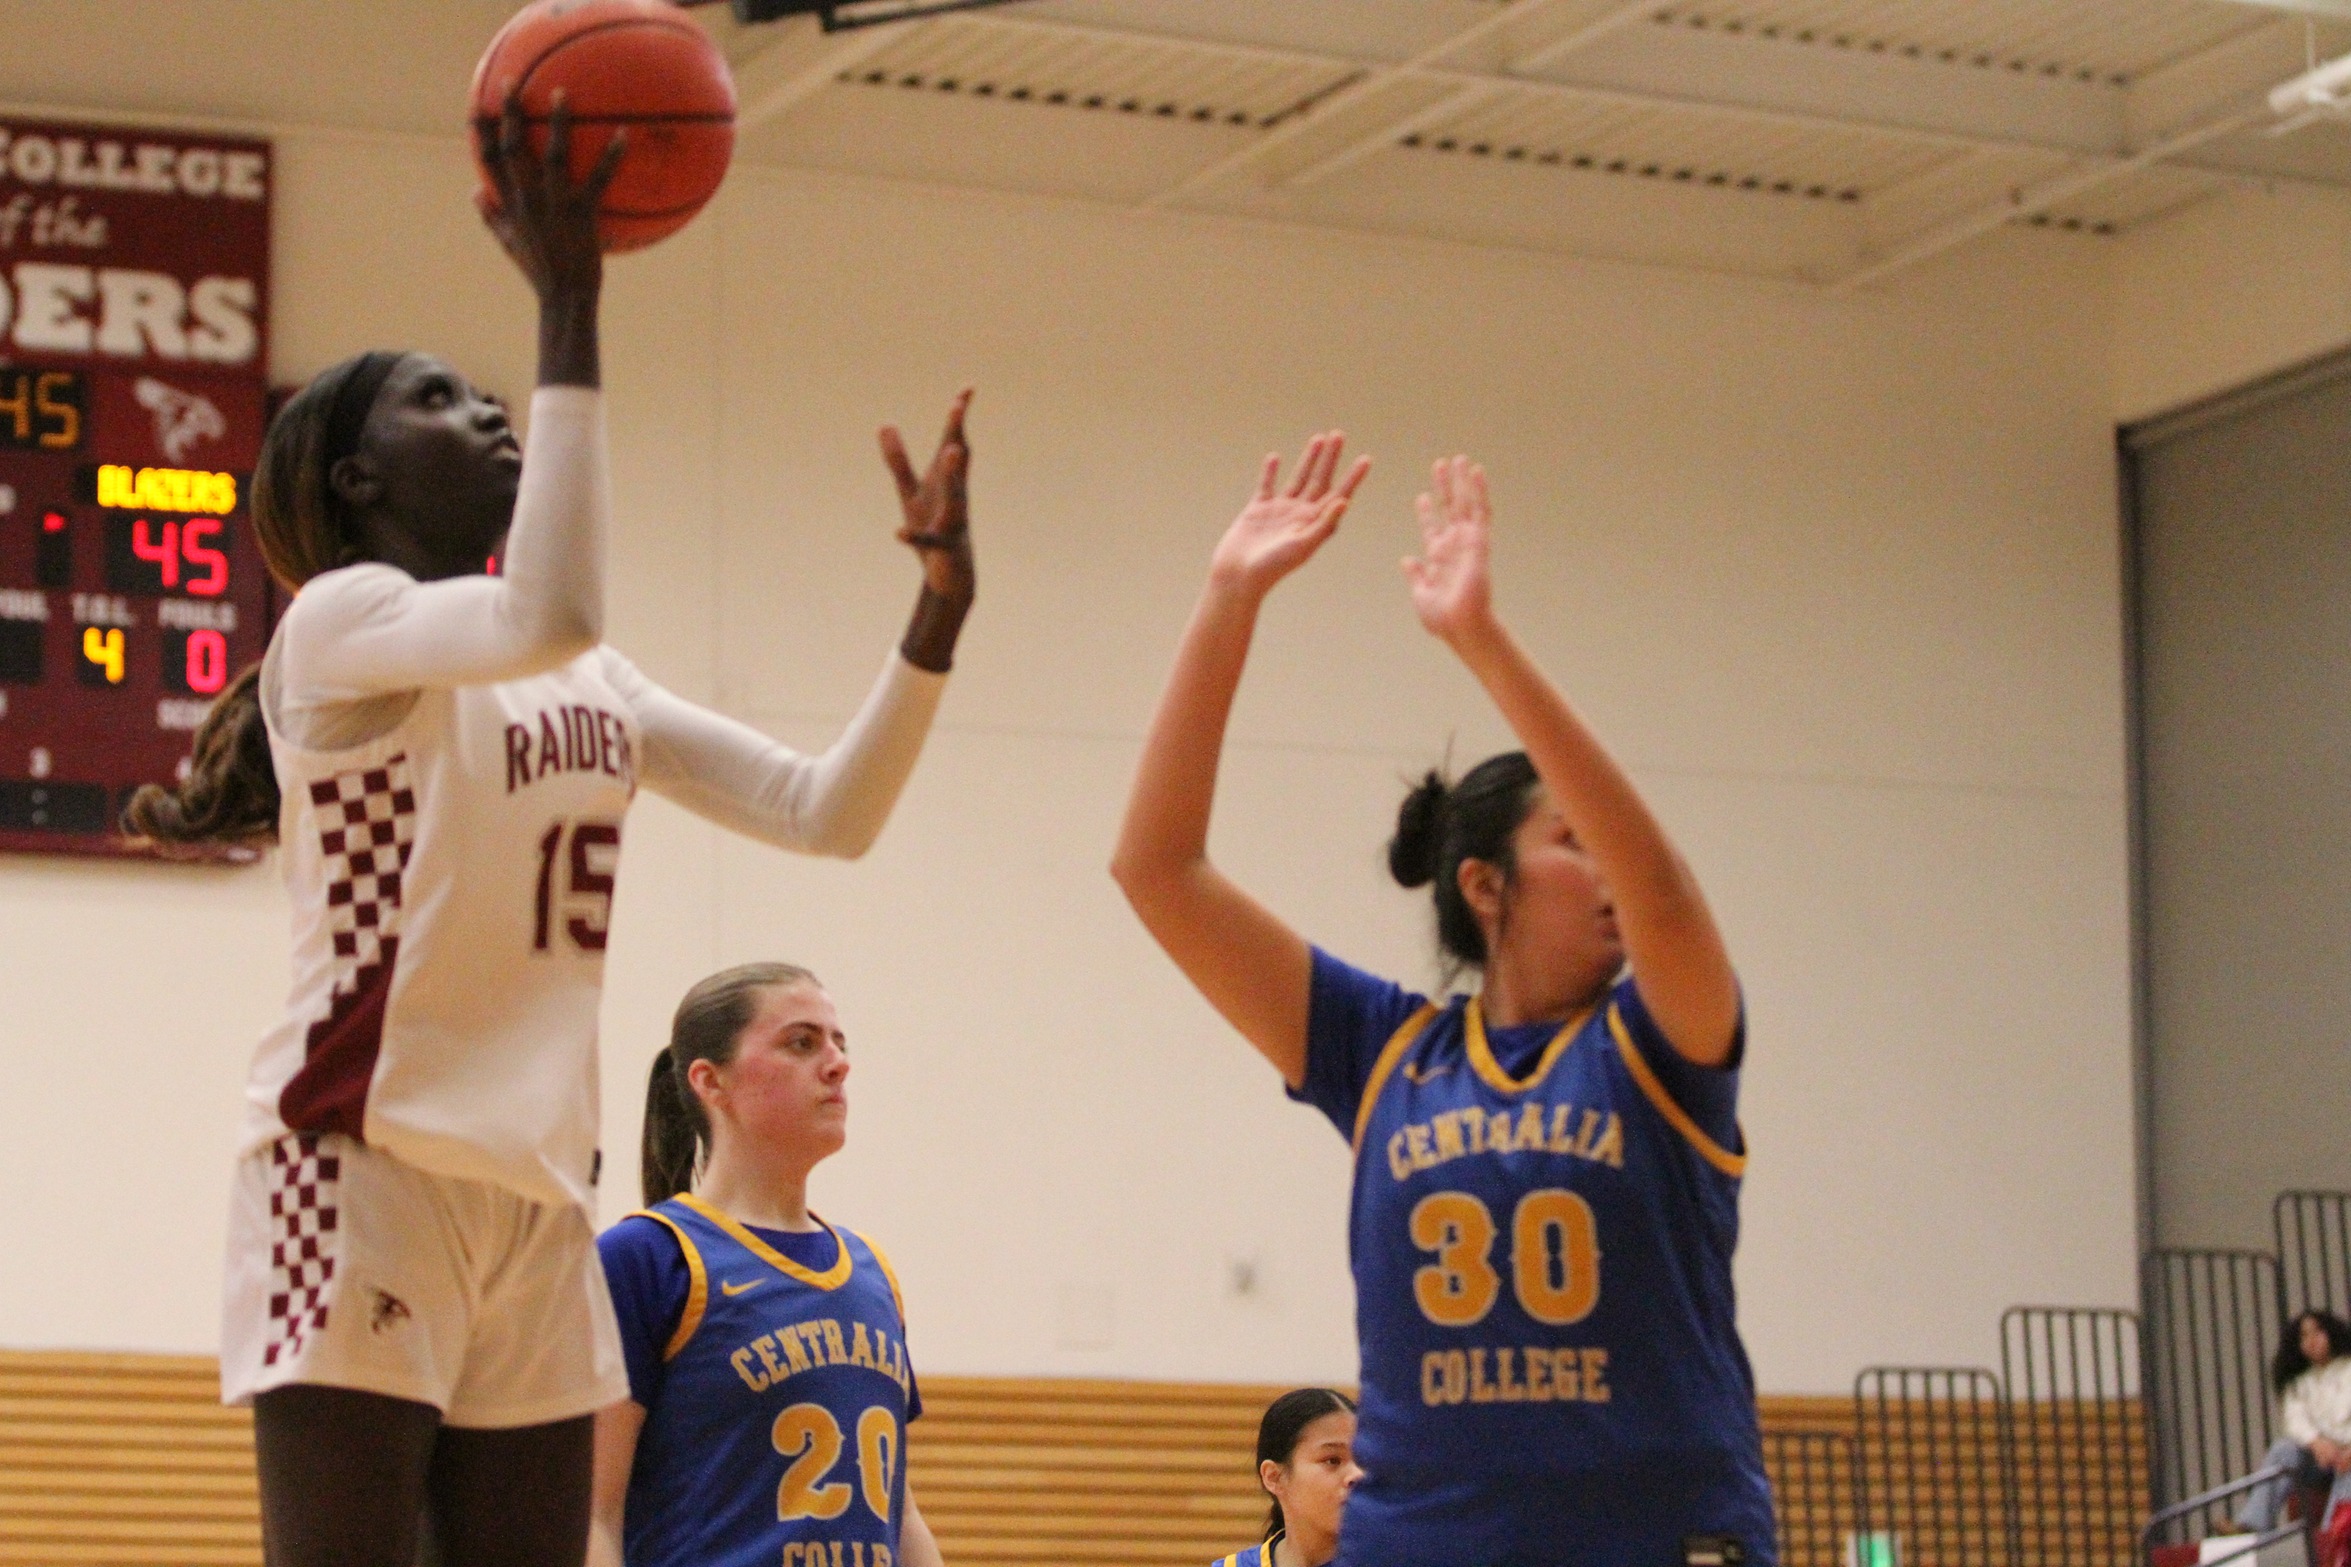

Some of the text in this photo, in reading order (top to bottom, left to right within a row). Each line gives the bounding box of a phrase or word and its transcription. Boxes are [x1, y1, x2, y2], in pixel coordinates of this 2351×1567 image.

[0, 129, 265, 199] OLLEGE
[0, 260, 258, 363] ERS
[132, 518, 229, 595] 45
[83, 627, 125, 684] 4
[186, 629, 227, 693] 0
[534, 822, 620, 951] 15
[1387, 1102, 1625, 1182] CENTRALIA
[1409, 1189, 1602, 1327] 30
[1420, 1346, 1612, 1407] COLLEGE
[771, 1402, 897, 1523] 20
